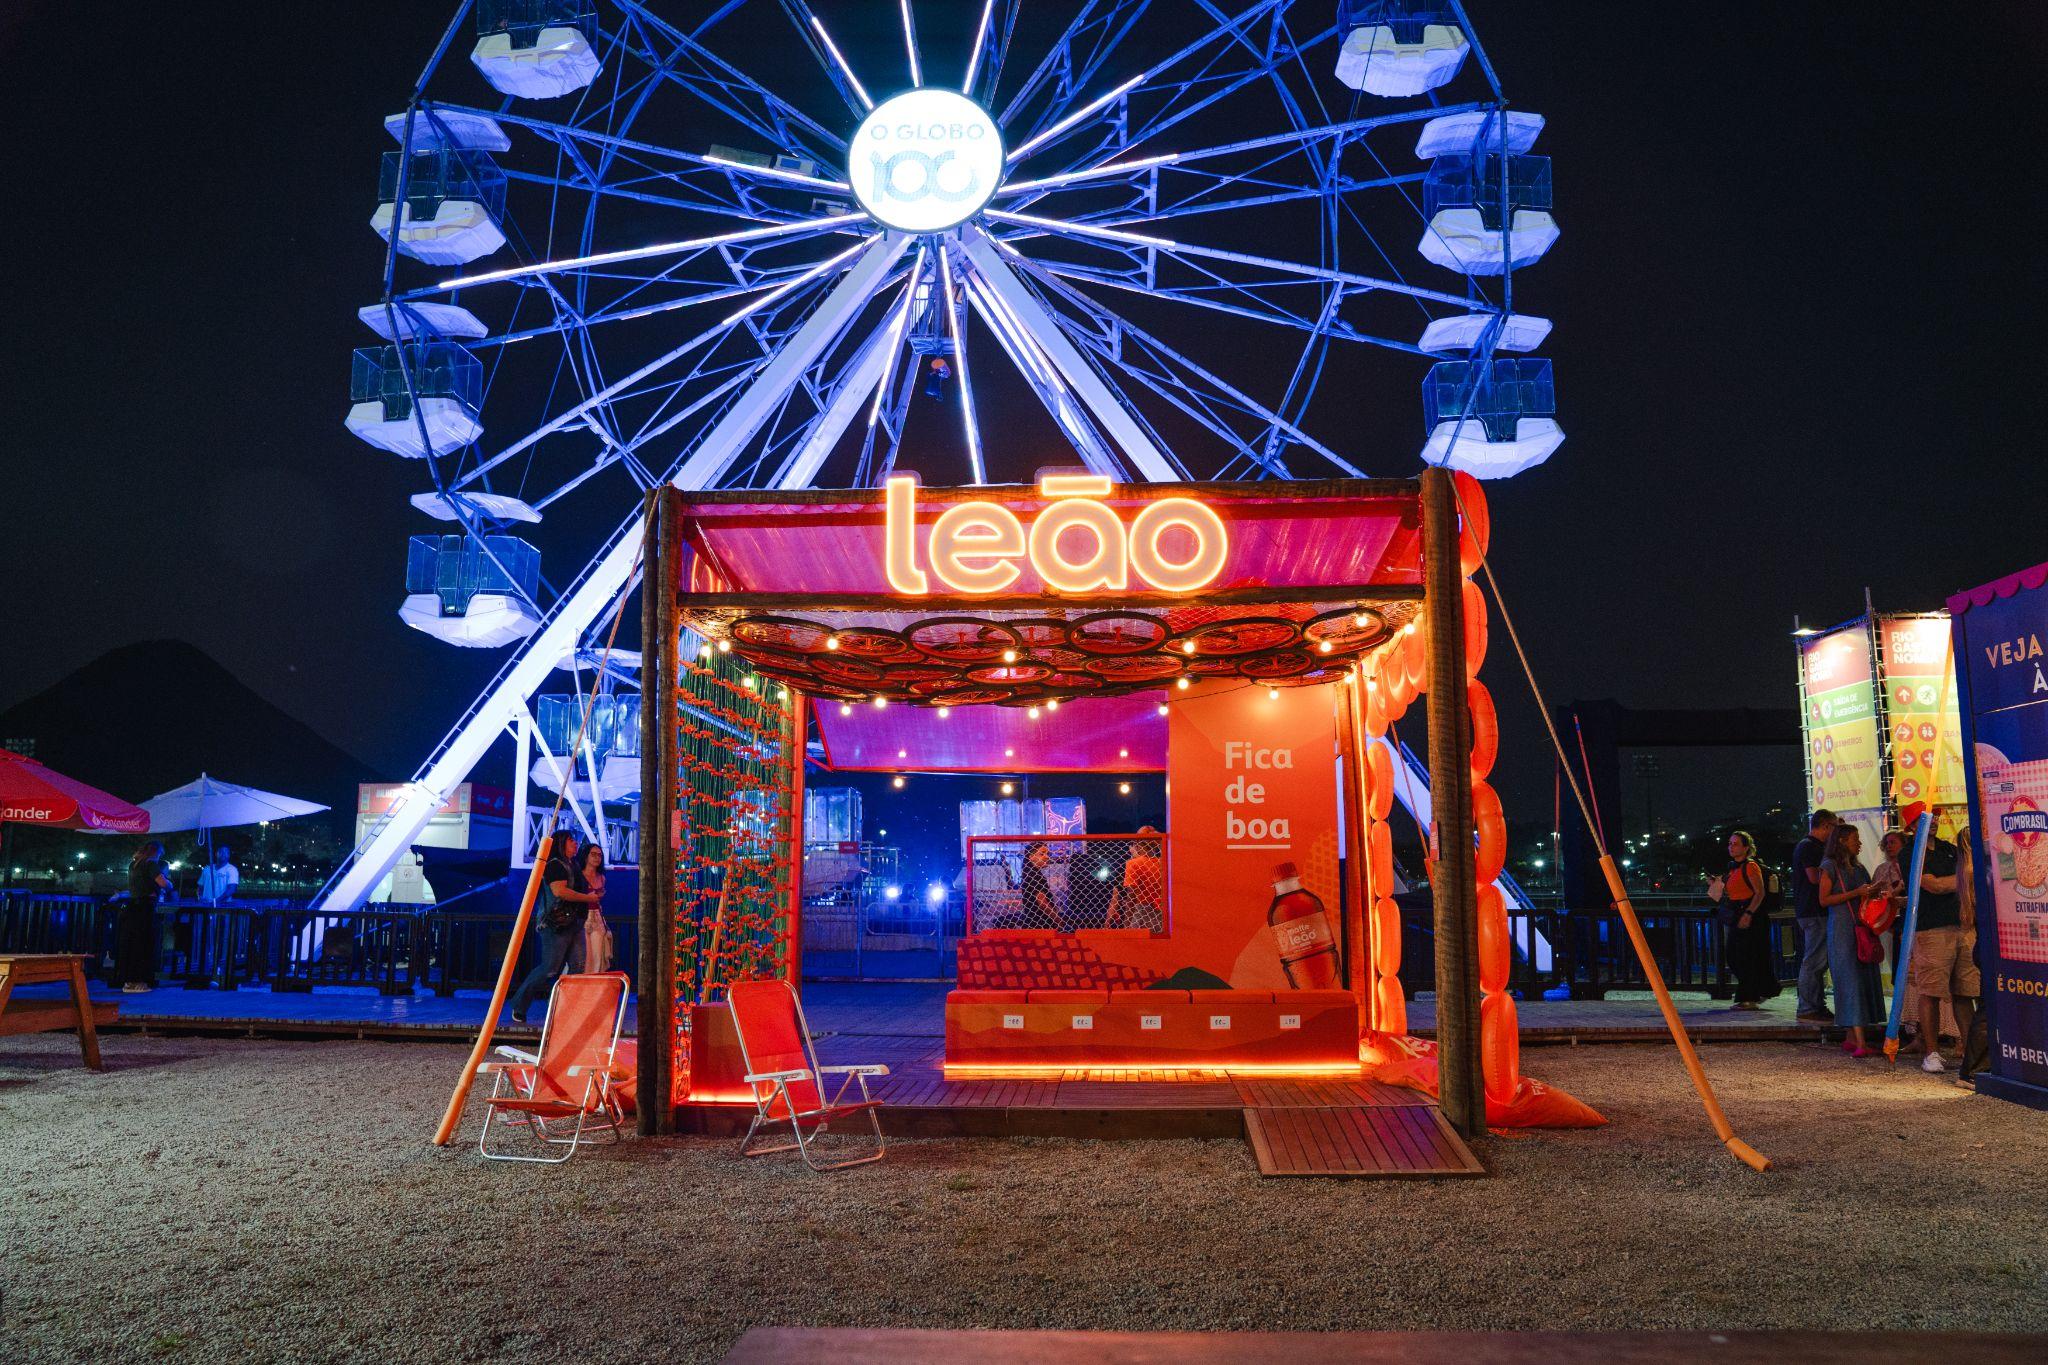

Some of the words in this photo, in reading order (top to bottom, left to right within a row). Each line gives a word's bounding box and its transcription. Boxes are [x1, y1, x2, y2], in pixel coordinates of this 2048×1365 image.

[870, 124, 888, 140] O
[897, 124, 985, 140] GLOBO
[884, 475, 1228, 595] leão
[1890, 631, 1915, 642] RIO
[1985, 633, 2044, 668] VEJA
[1225, 741, 1293, 769] Fica
[1224, 775, 1265, 804] de
[0, 807, 52, 820] ander
[99, 815, 140, 829] Santander
[1226, 810, 1291, 840] boa
[2003, 814, 2048, 832] COMBRASIL
[1287, 924, 1310, 935] matte
[1289, 931, 1317, 945] leão
[1997, 973, 2004, 992] É
[2002, 1044, 2018, 1060] EM
